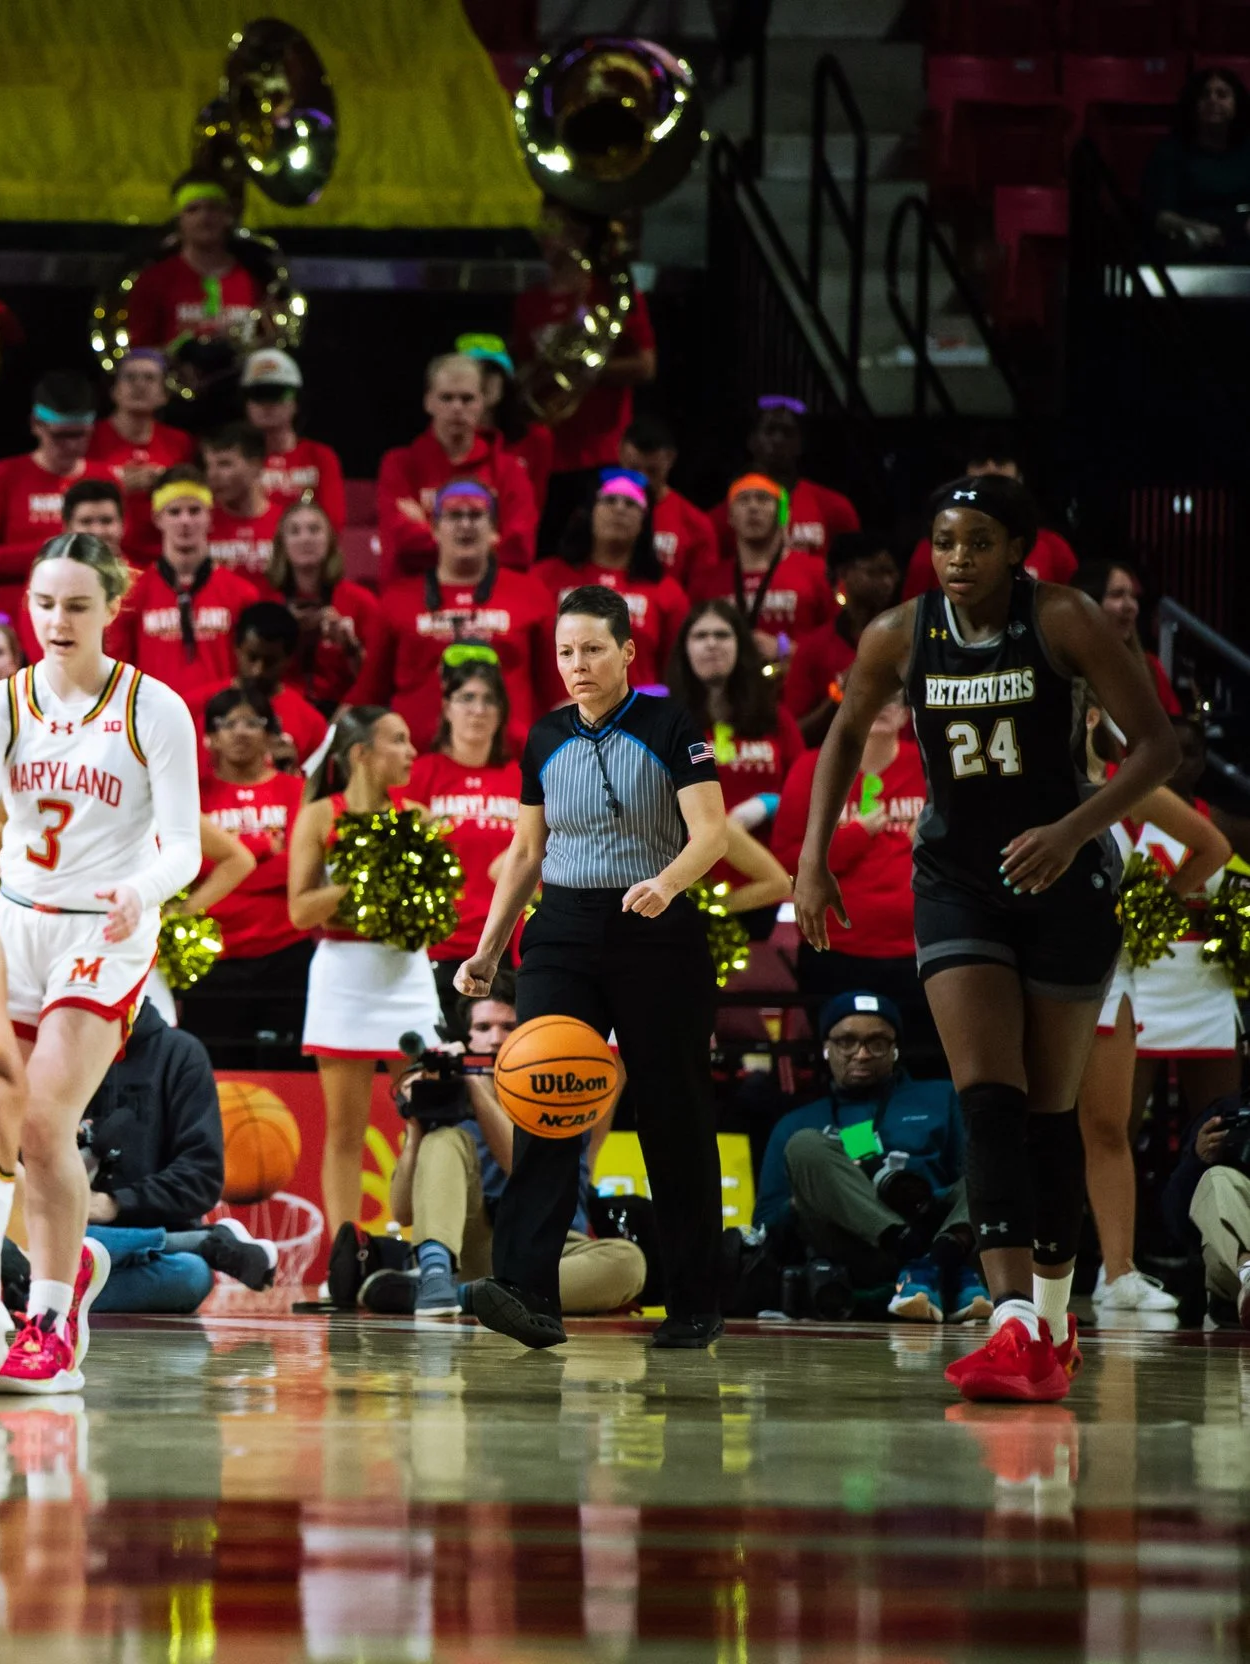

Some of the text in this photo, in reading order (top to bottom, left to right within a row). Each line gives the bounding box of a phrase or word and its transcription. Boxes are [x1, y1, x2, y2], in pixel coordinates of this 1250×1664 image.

[926, 669, 1034, 706] RETRIEVERS
[946, 718, 1022, 778] 24
[10, 761, 122, 808] MARYLAND
[26, 799, 74, 871] 3
[69, 956, 105, 983] M
[530, 1072, 607, 1094] Wilson
[538, 1109, 597, 1127] NCAA
